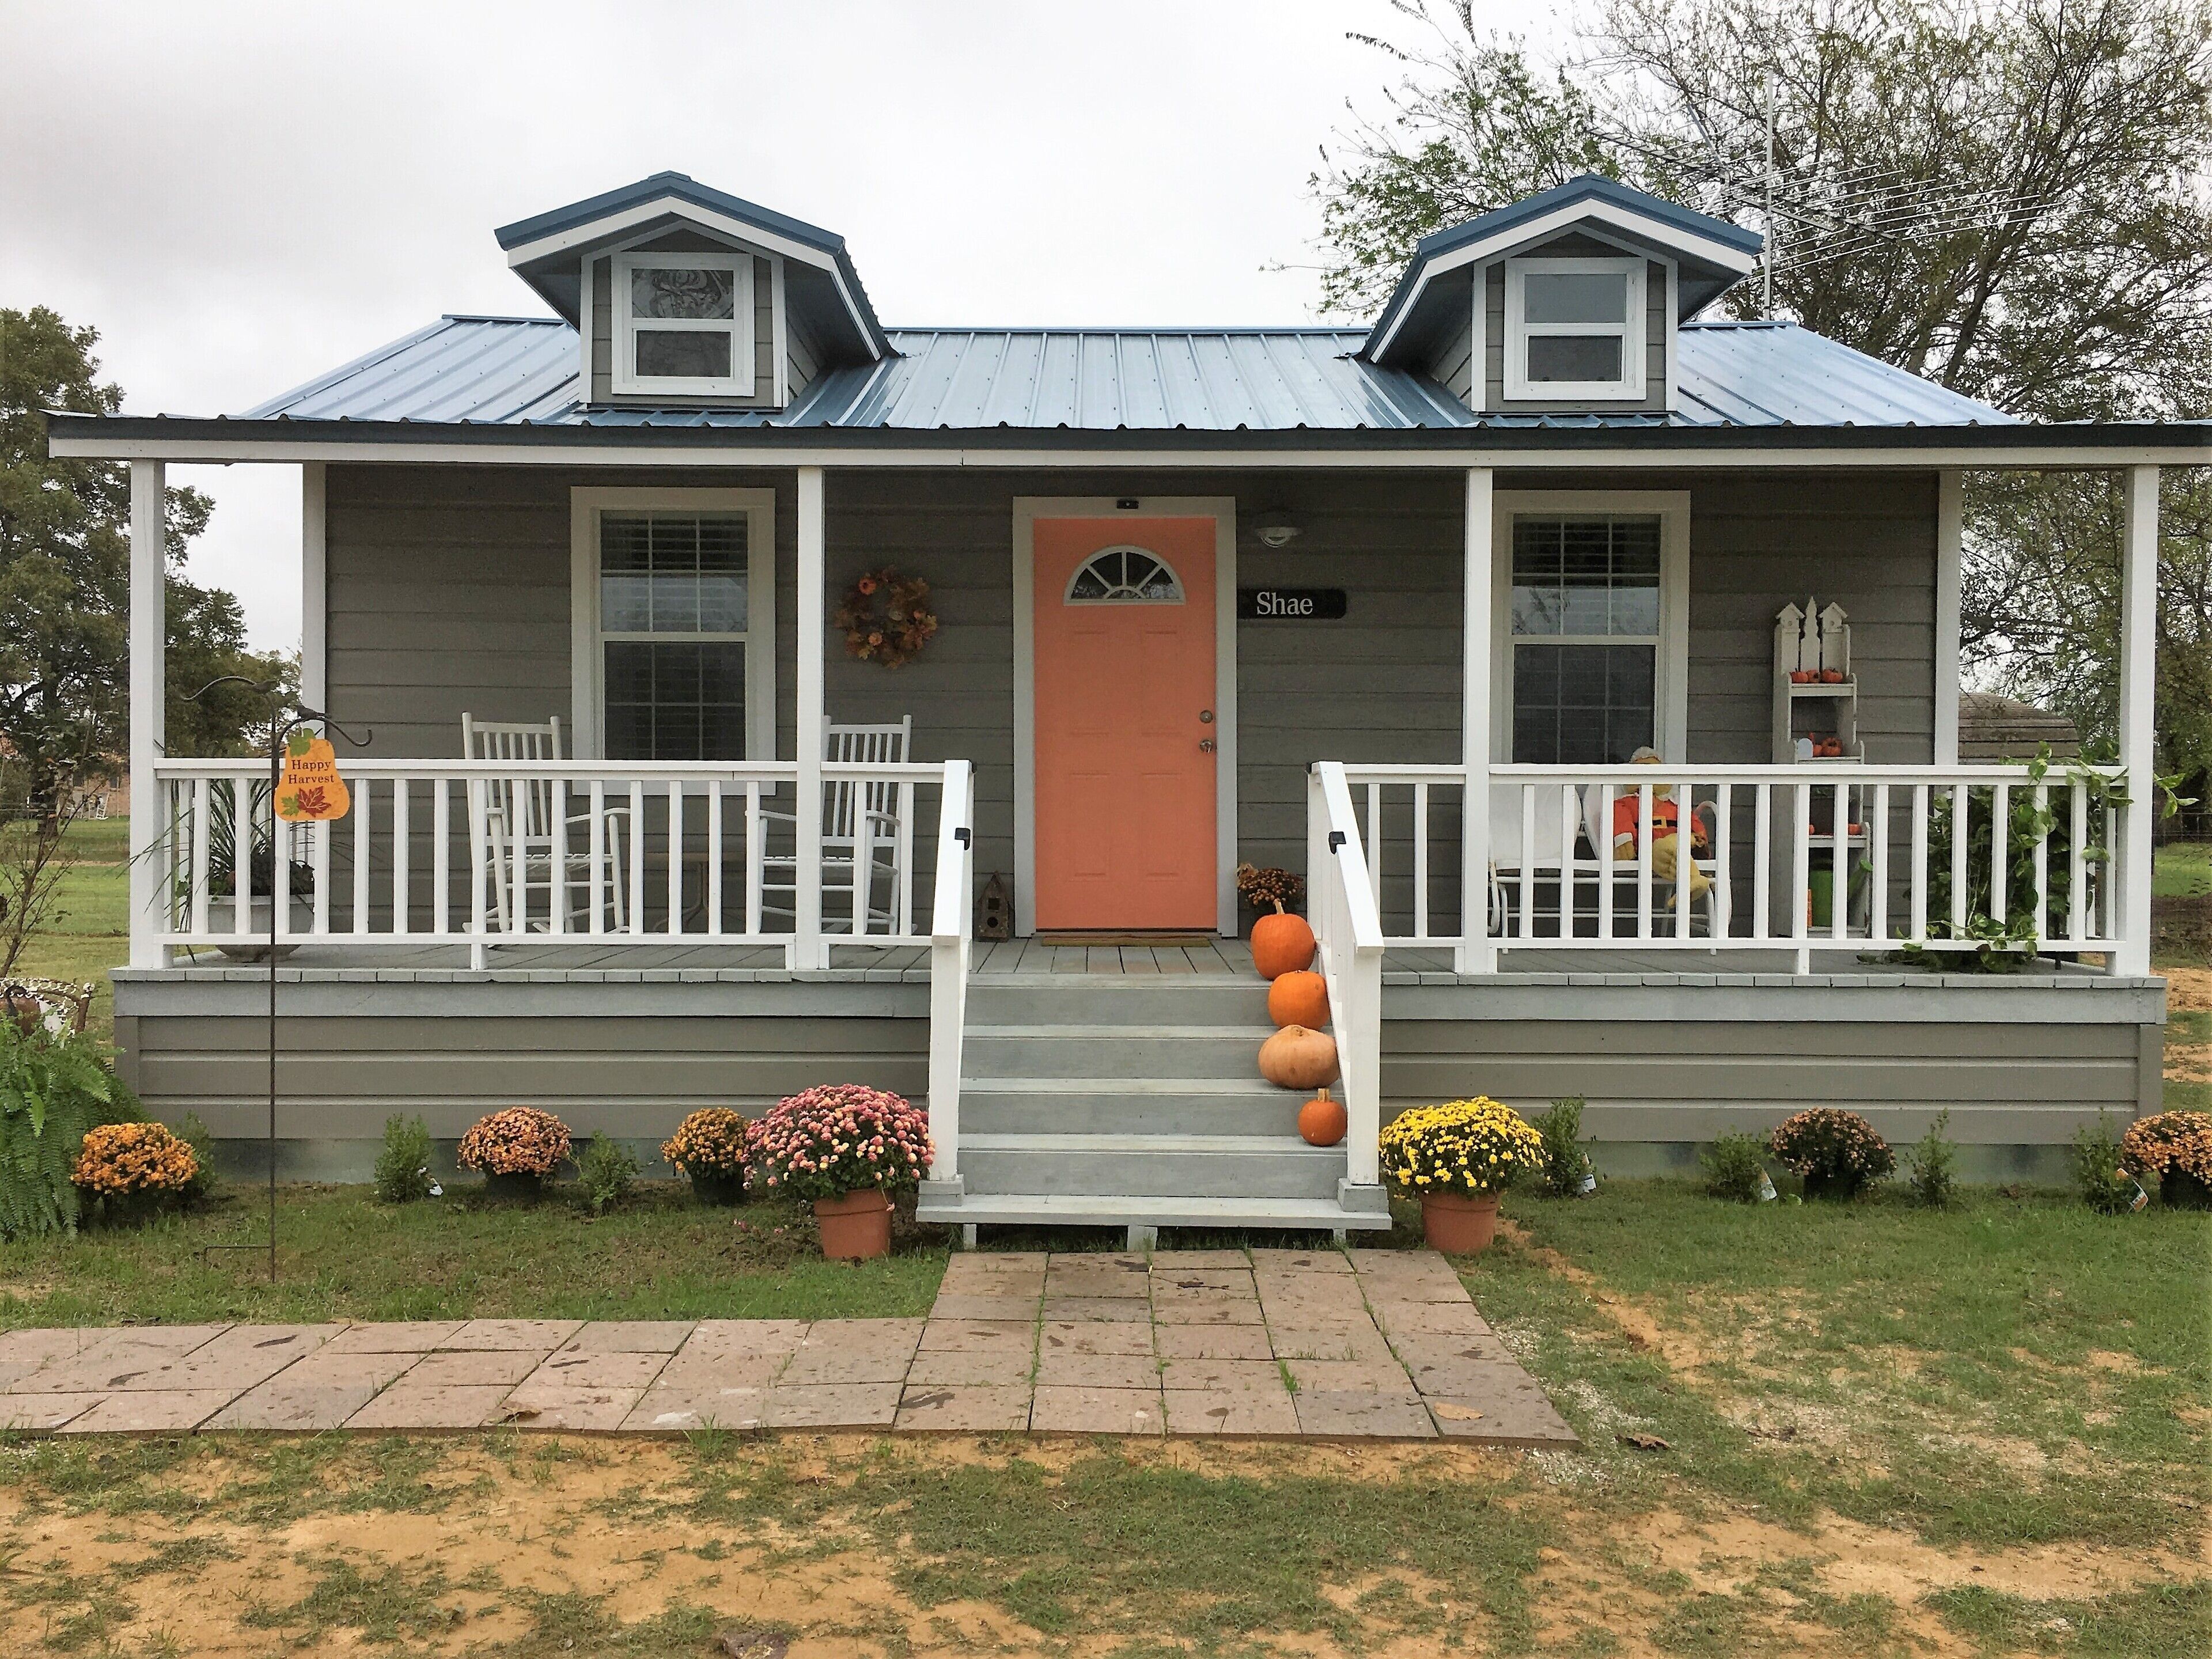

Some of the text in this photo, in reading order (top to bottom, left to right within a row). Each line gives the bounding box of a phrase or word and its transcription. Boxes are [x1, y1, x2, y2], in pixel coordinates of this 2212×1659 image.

[1256, 592, 1313, 615] Shae
[291, 759, 331, 771] Happy
[288, 774, 335, 784] Harvest
